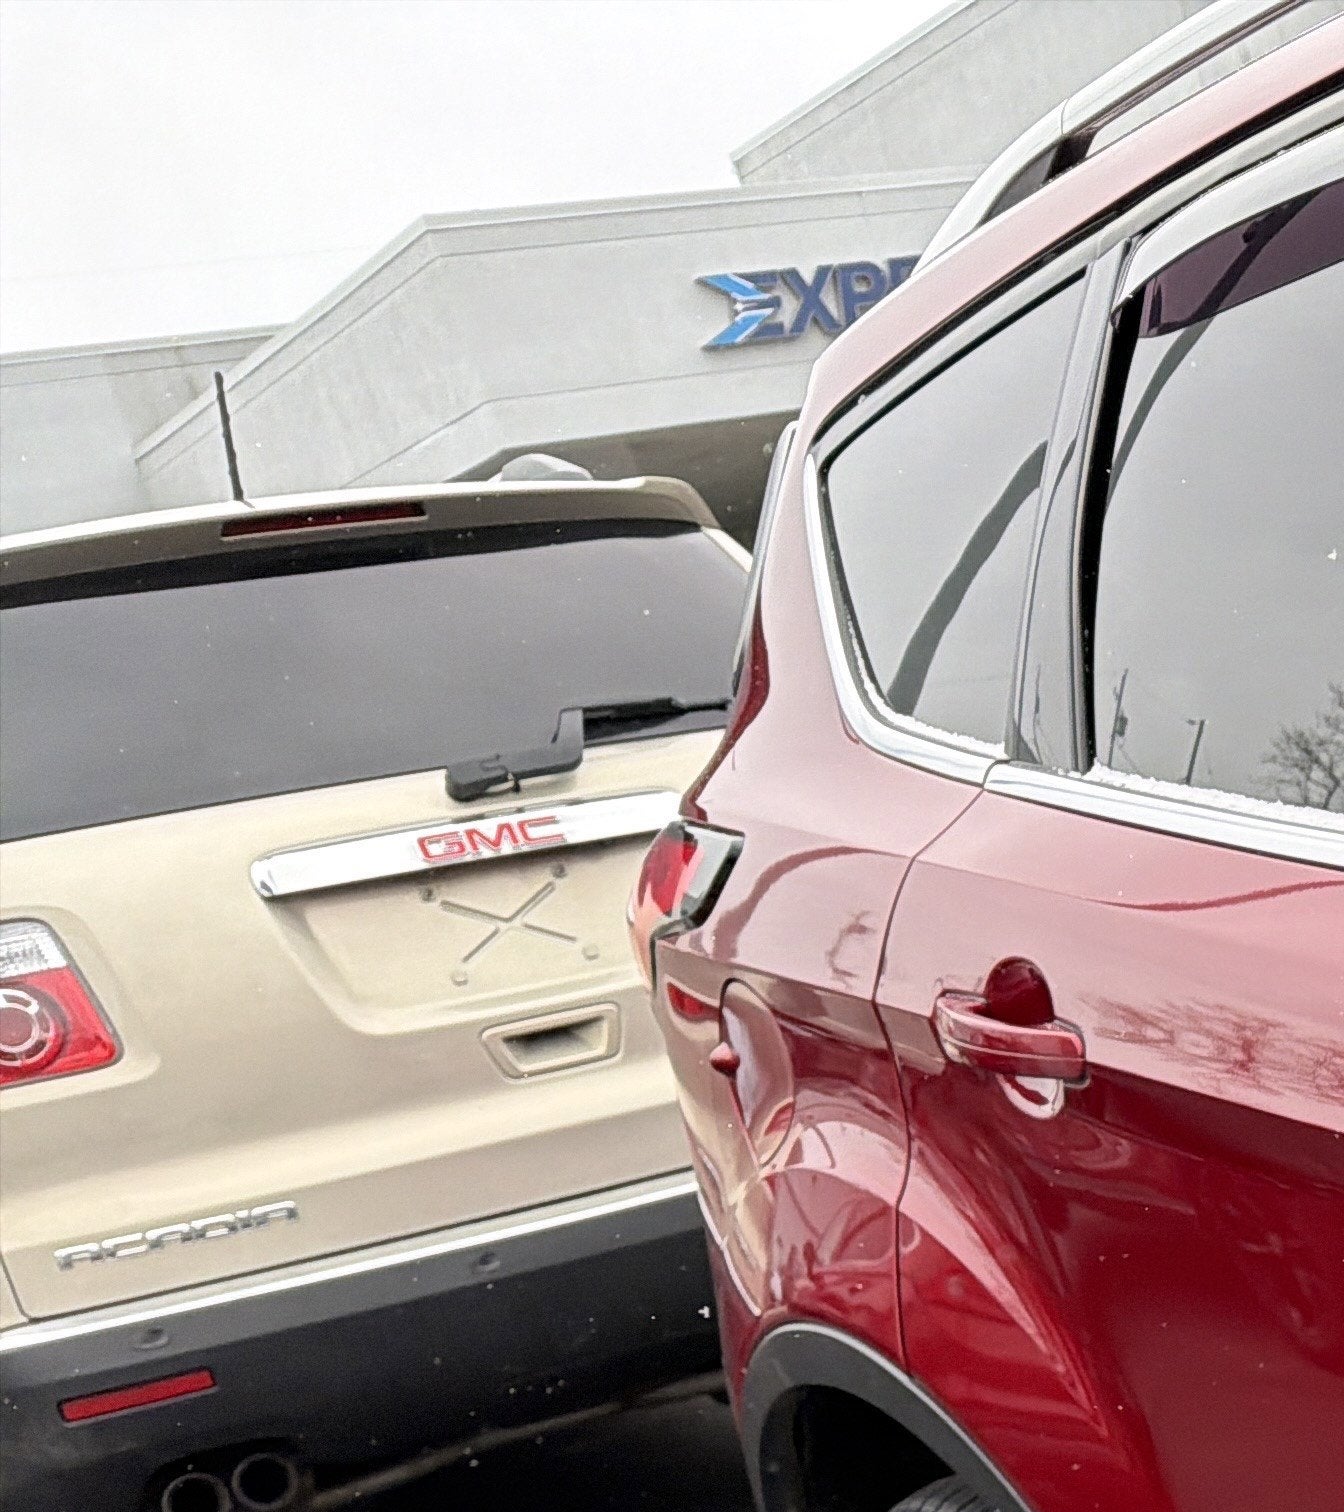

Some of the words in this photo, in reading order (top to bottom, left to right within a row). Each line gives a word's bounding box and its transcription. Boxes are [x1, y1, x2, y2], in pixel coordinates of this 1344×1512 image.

[696, 253, 922, 350] EXP
[417, 816, 565, 863] GMC
[54, 1200, 298, 1271] ACADIA
